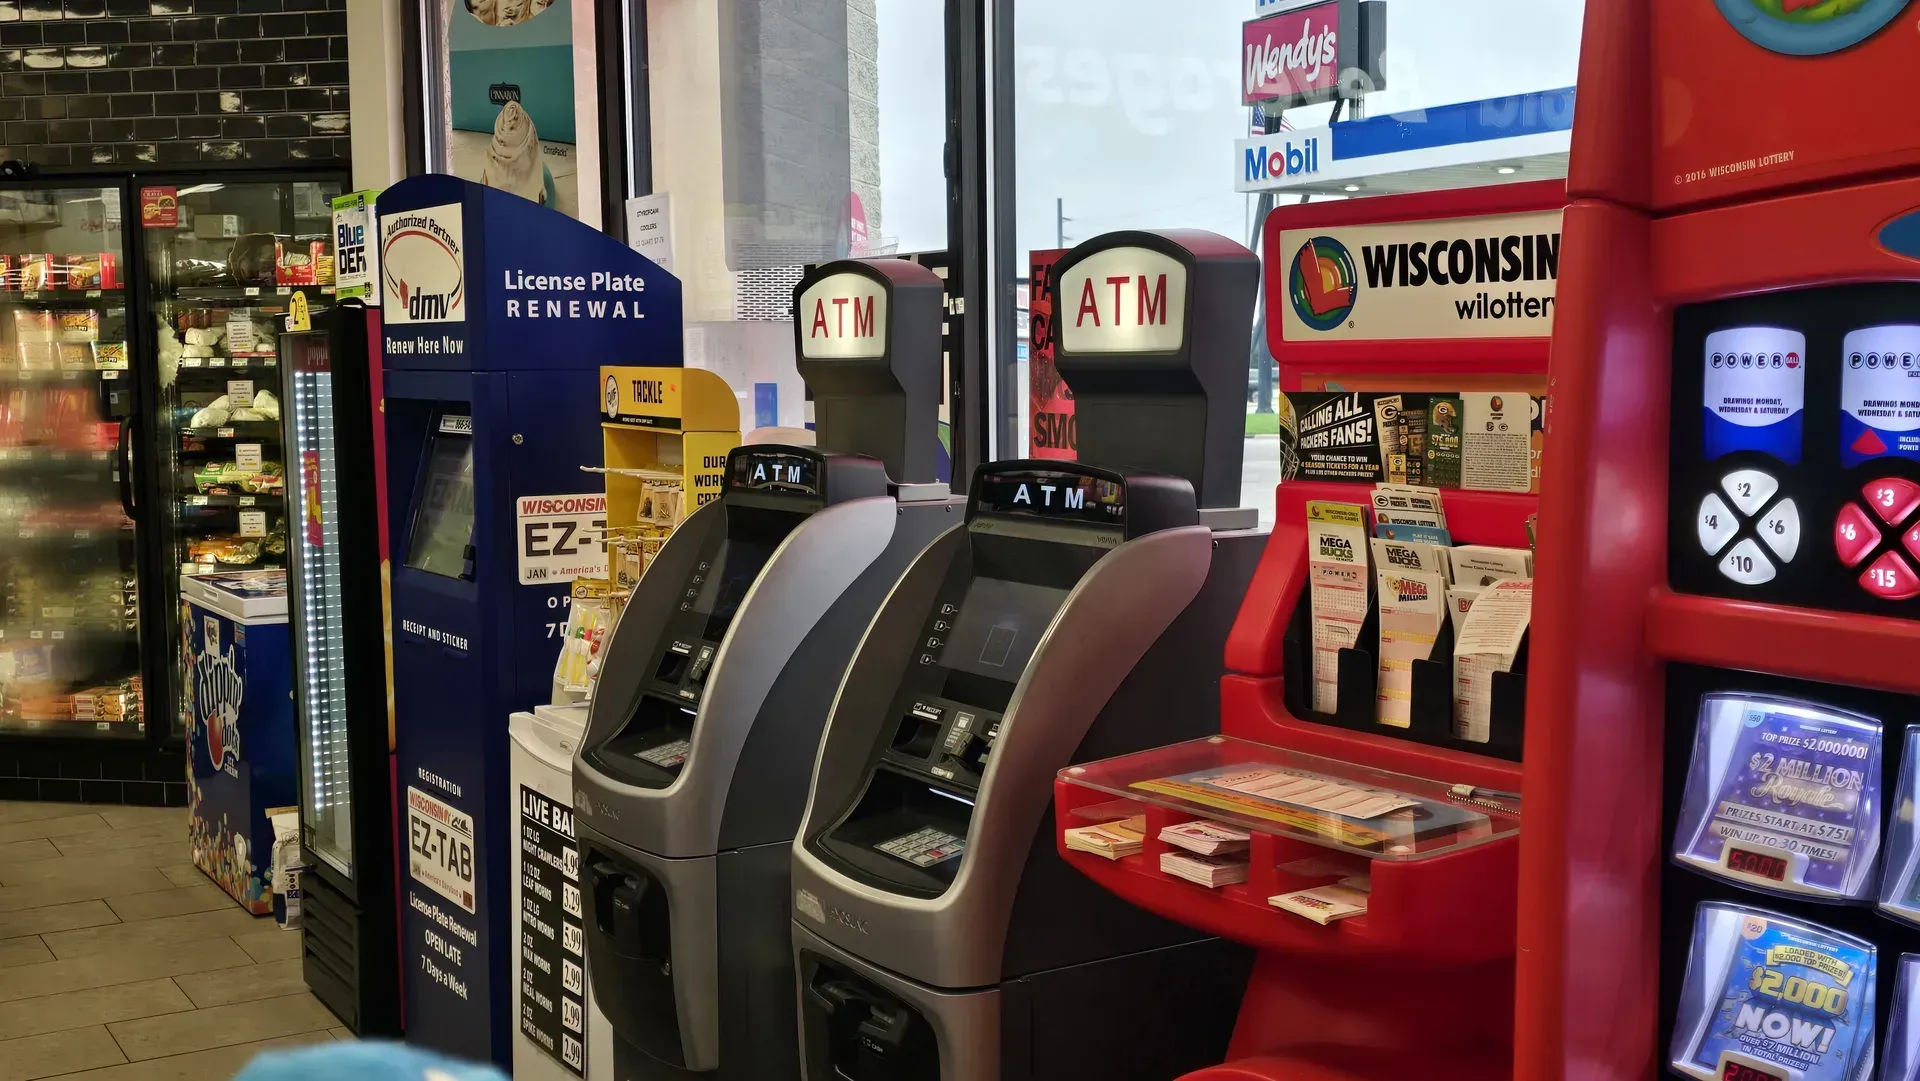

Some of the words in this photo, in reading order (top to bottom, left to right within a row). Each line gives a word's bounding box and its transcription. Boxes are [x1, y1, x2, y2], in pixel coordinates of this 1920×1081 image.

[1246, 18, 1336, 95] Wendy's
[491, 89, 519, 101] CINNABON
[1245, 138, 1319, 182] Mobil
[1685, 170, 1707, 184] 2016
[1709, 159, 1756, 178] WISCONSIN
[1758, 150, 1795, 168] LOTTERY
[337, 223, 364, 248] Blue
[387, 213, 428, 237] Authorized
[428, 219, 460, 255] Partner
[640, 223, 657, 232] COOLERS
[339, 246, 365, 276] DEF
[1362, 233, 1561, 288] WISCONSIN
[504, 270, 586, 291] License
[591, 272, 645, 291] Plate
[409, 286, 452, 320] dmv
[507, 300, 645, 319] RENEWAL
[1075, 274, 1167, 328] ATM
[812, 295, 874, 338] ATM
[386, 337, 414, 354] Renew
[417, 336, 440, 354] Here
[442, 336, 463, 354] Now
[632, 380, 663, 404] TACKLE
[1723, 397, 1754, 405] DRAWINGS
[1755, 398, 1783, 406] MONDAY,
[1863, 400, 1897, 408] DRAWINGS
[1300, 405, 1333, 433] CALLING
[1335, 391, 1363, 422] ALL
[1718, 406, 1753, 414] WEDNESDAY
[1759, 407, 1789, 415] SATURDAY
[1857, 409, 1896, 418] WEDNESDAY
[1300, 431, 1329, 450] PACKERS
[1331, 417, 1373, 447] FANS!
[704, 456, 726, 468] OUR
[1326, 462, 1347, 470] TICKETS
[1348, 455, 1355, 463] TO
[754, 463, 801, 484] ATM
[1013, 483, 1084, 510] ATM
[1737, 482, 1751, 497] $2
[1877, 489, 1895, 507] $3
[1704, 514, 1718, 529] $4
[1769, 519, 1785, 534] $6
[1840, 523, 1856, 540] $6
[1320, 537, 1352, 549] MEGA
[1320, 547, 1354, 559] BUCKS
[1385, 547, 1419, 560] MEGA
[526, 568, 547, 579] JAN
[560, 565, 601, 575] America's
[1387, 556, 1421, 567] BUCKS
[1730, 556, 1753, 573] $10
[1399, 580, 1428, 595] MEGA
[1870, 569, 1896, 588] $15
[402, 619, 426, 636] RECEIPT
[428, 628, 441, 641] AND
[442, 632, 468, 650] STICKER
[546, 623, 556, 638] 7
[1761, 731, 1778, 742] TOP
[1779, 735, 1801, 746] PRIZE
[1803, 738, 1869, 760] $2,000,000!
[418, 767, 461, 798] REGISTRATION
[1749, 751, 1774, 774] $2
[1776, 756, 1864, 792] MILLION
[1750, 772, 1844, 810] Royale
[410, 791, 444, 822] WISCONSIN
[522, 790, 549, 825] LIVE
[552, 805, 575, 838] BAI
[1725, 806, 1762, 824] PRIZES
[1764, 814, 1798, 832] START
[1799, 823, 1815, 835] AT
[1817, 825, 1849, 841] $75!
[411, 814, 472, 882] EZ-TAB
[1720, 826, 1743, 839] WIN
[1744, 832, 1759, 843] UP
[1762, 835, 1778, 847] TO
[1780, 838, 1798, 851] 30
[1800, 843, 1838, 860] TIMES!
[537, 847, 563, 871] CRAWLERS
[564, 888, 580, 913] 3.29
[410, 890, 432, 918] License
[432, 905, 449, 929] Plate
[449, 915, 477, 947] Renewal
[1747, 922, 1763, 934] $20
[425, 929, 444, 955] OPEN
[445, 941, 462, 967] LATE
[564, 926, 581, 951] 5.99
[1784, 947, 1816, 960] LOADED
[1817, 953, 1838, 966] WITH
[1803, 957, 1817, 966] TOP
[1818, 961, 1846, 980] PRIZES!
[421, 954, 426, 970] 7
[427, 958, 443, 983] Days
[443, 973, 448, 986] a
[448, 972, 468, 1001] Week
[564, 964, 580, 990] 2.99
[1749, 965, 1848, 1017] $2,000
[564, 1002, 580, 1028] 2.99
[1734, 1002, 1836, 1054] NOW!
[523, 1018, 536, 1037] SPIKE
[565, 1038, 580, 1065] 2.99
[1740, 1034, 1760, 1046] OVER
[1762, 1039, 1775, 1050] $7
[1776, 1043, 1820, 1064] MILLION
[1742, 1045, 1751, 1053] IN
[1778, 1056, 1809, 1071] PRIZES!
